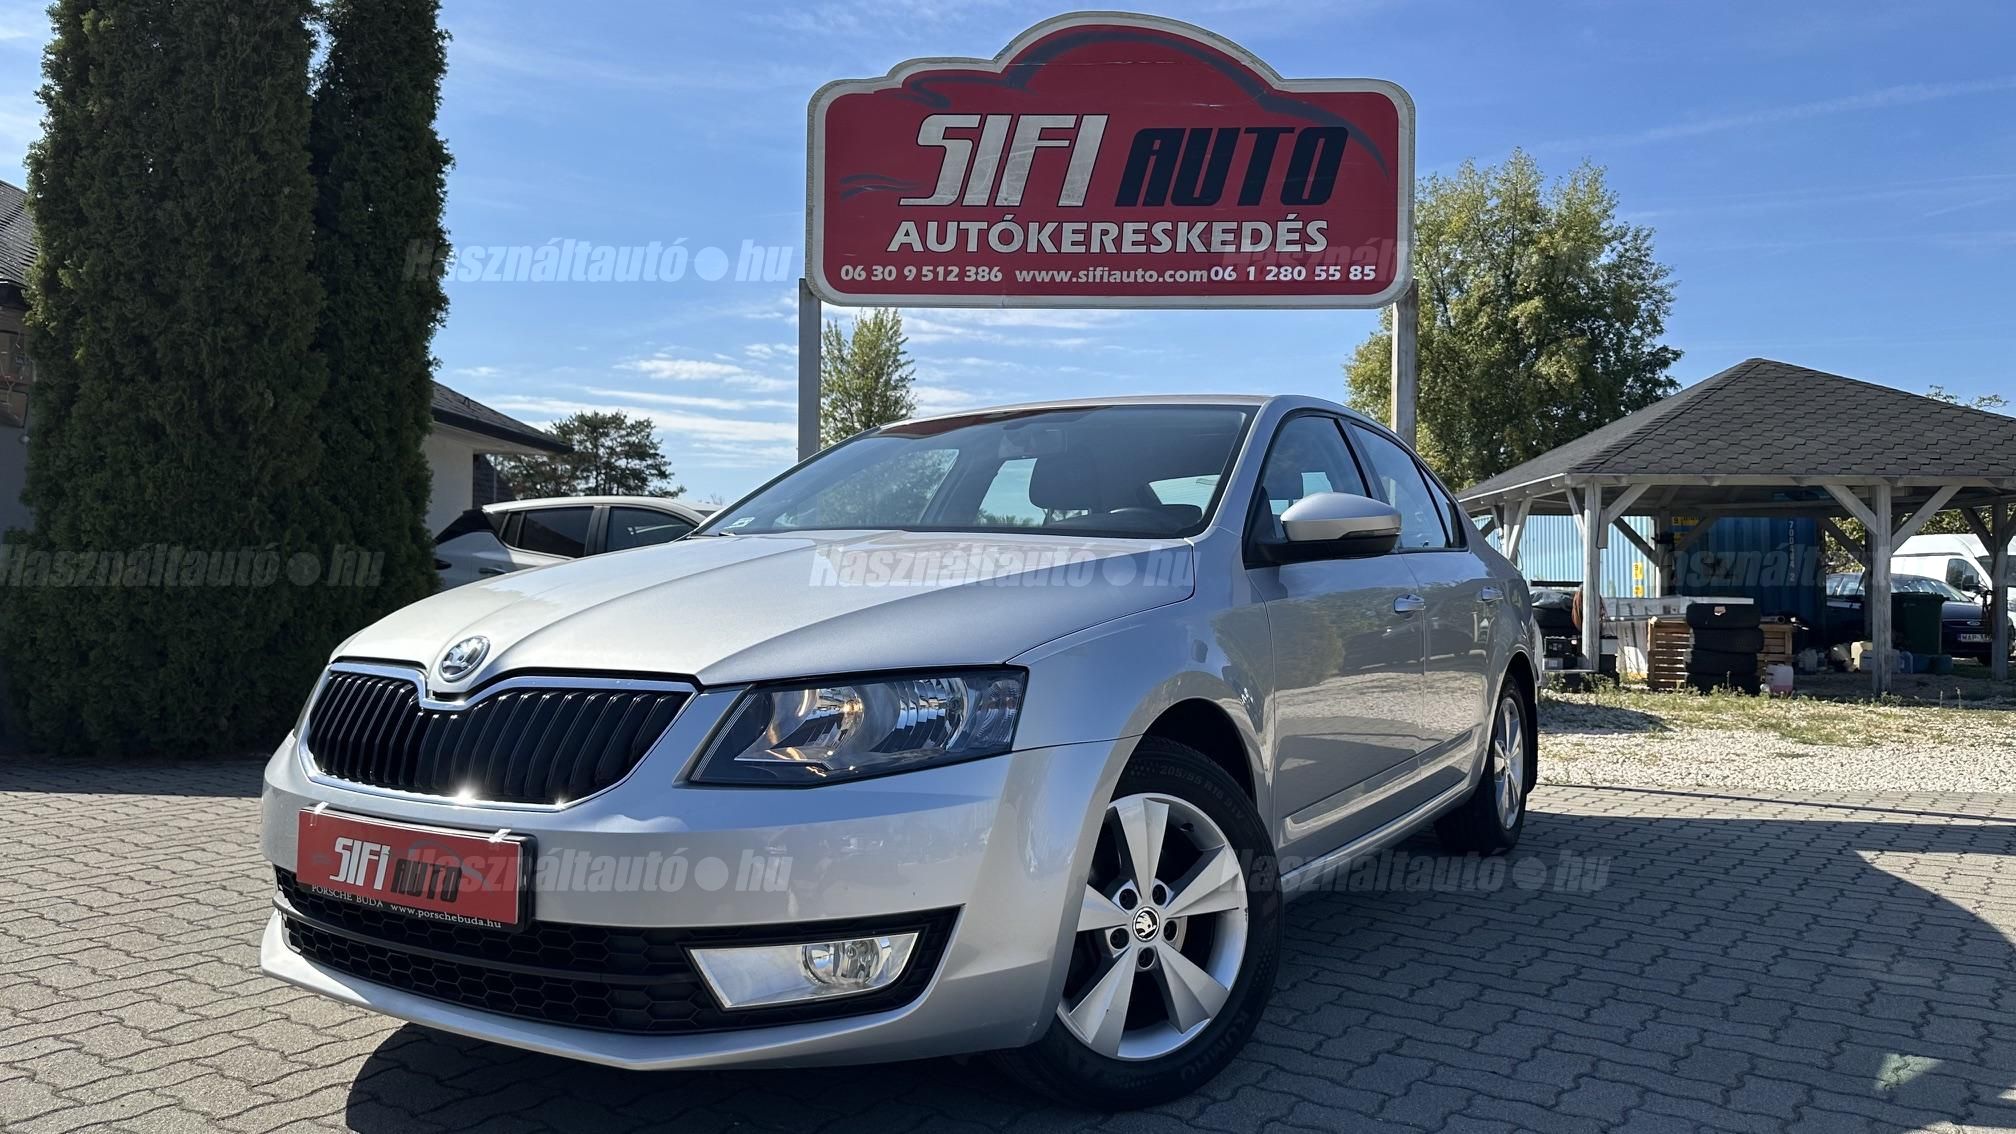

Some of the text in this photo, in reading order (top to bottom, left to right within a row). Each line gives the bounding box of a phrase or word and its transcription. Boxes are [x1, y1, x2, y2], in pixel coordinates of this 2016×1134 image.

[899, 114, 1348, 207] SIFI AUTO
[887, 213, 1328, 254] AUTÓKERESKEDÉS
[840, 264, 867, 281] 06
[871, 265, 896, 281] 30
[964, 266, 1003, 282] 386
[1015, 266, 1207, 283] www.sifiauto.com
[1210, 265, 1237, 281] 06
[1246, 266, 1255, 281] 1
[1265, 265, 1306, 281] 280
[1314, 265, 1341, 281] 55
[1349, 265, 1376, 281] 85
[311, 884, 502, 929] PORSCHE BUDA www.porschebuda.hu
